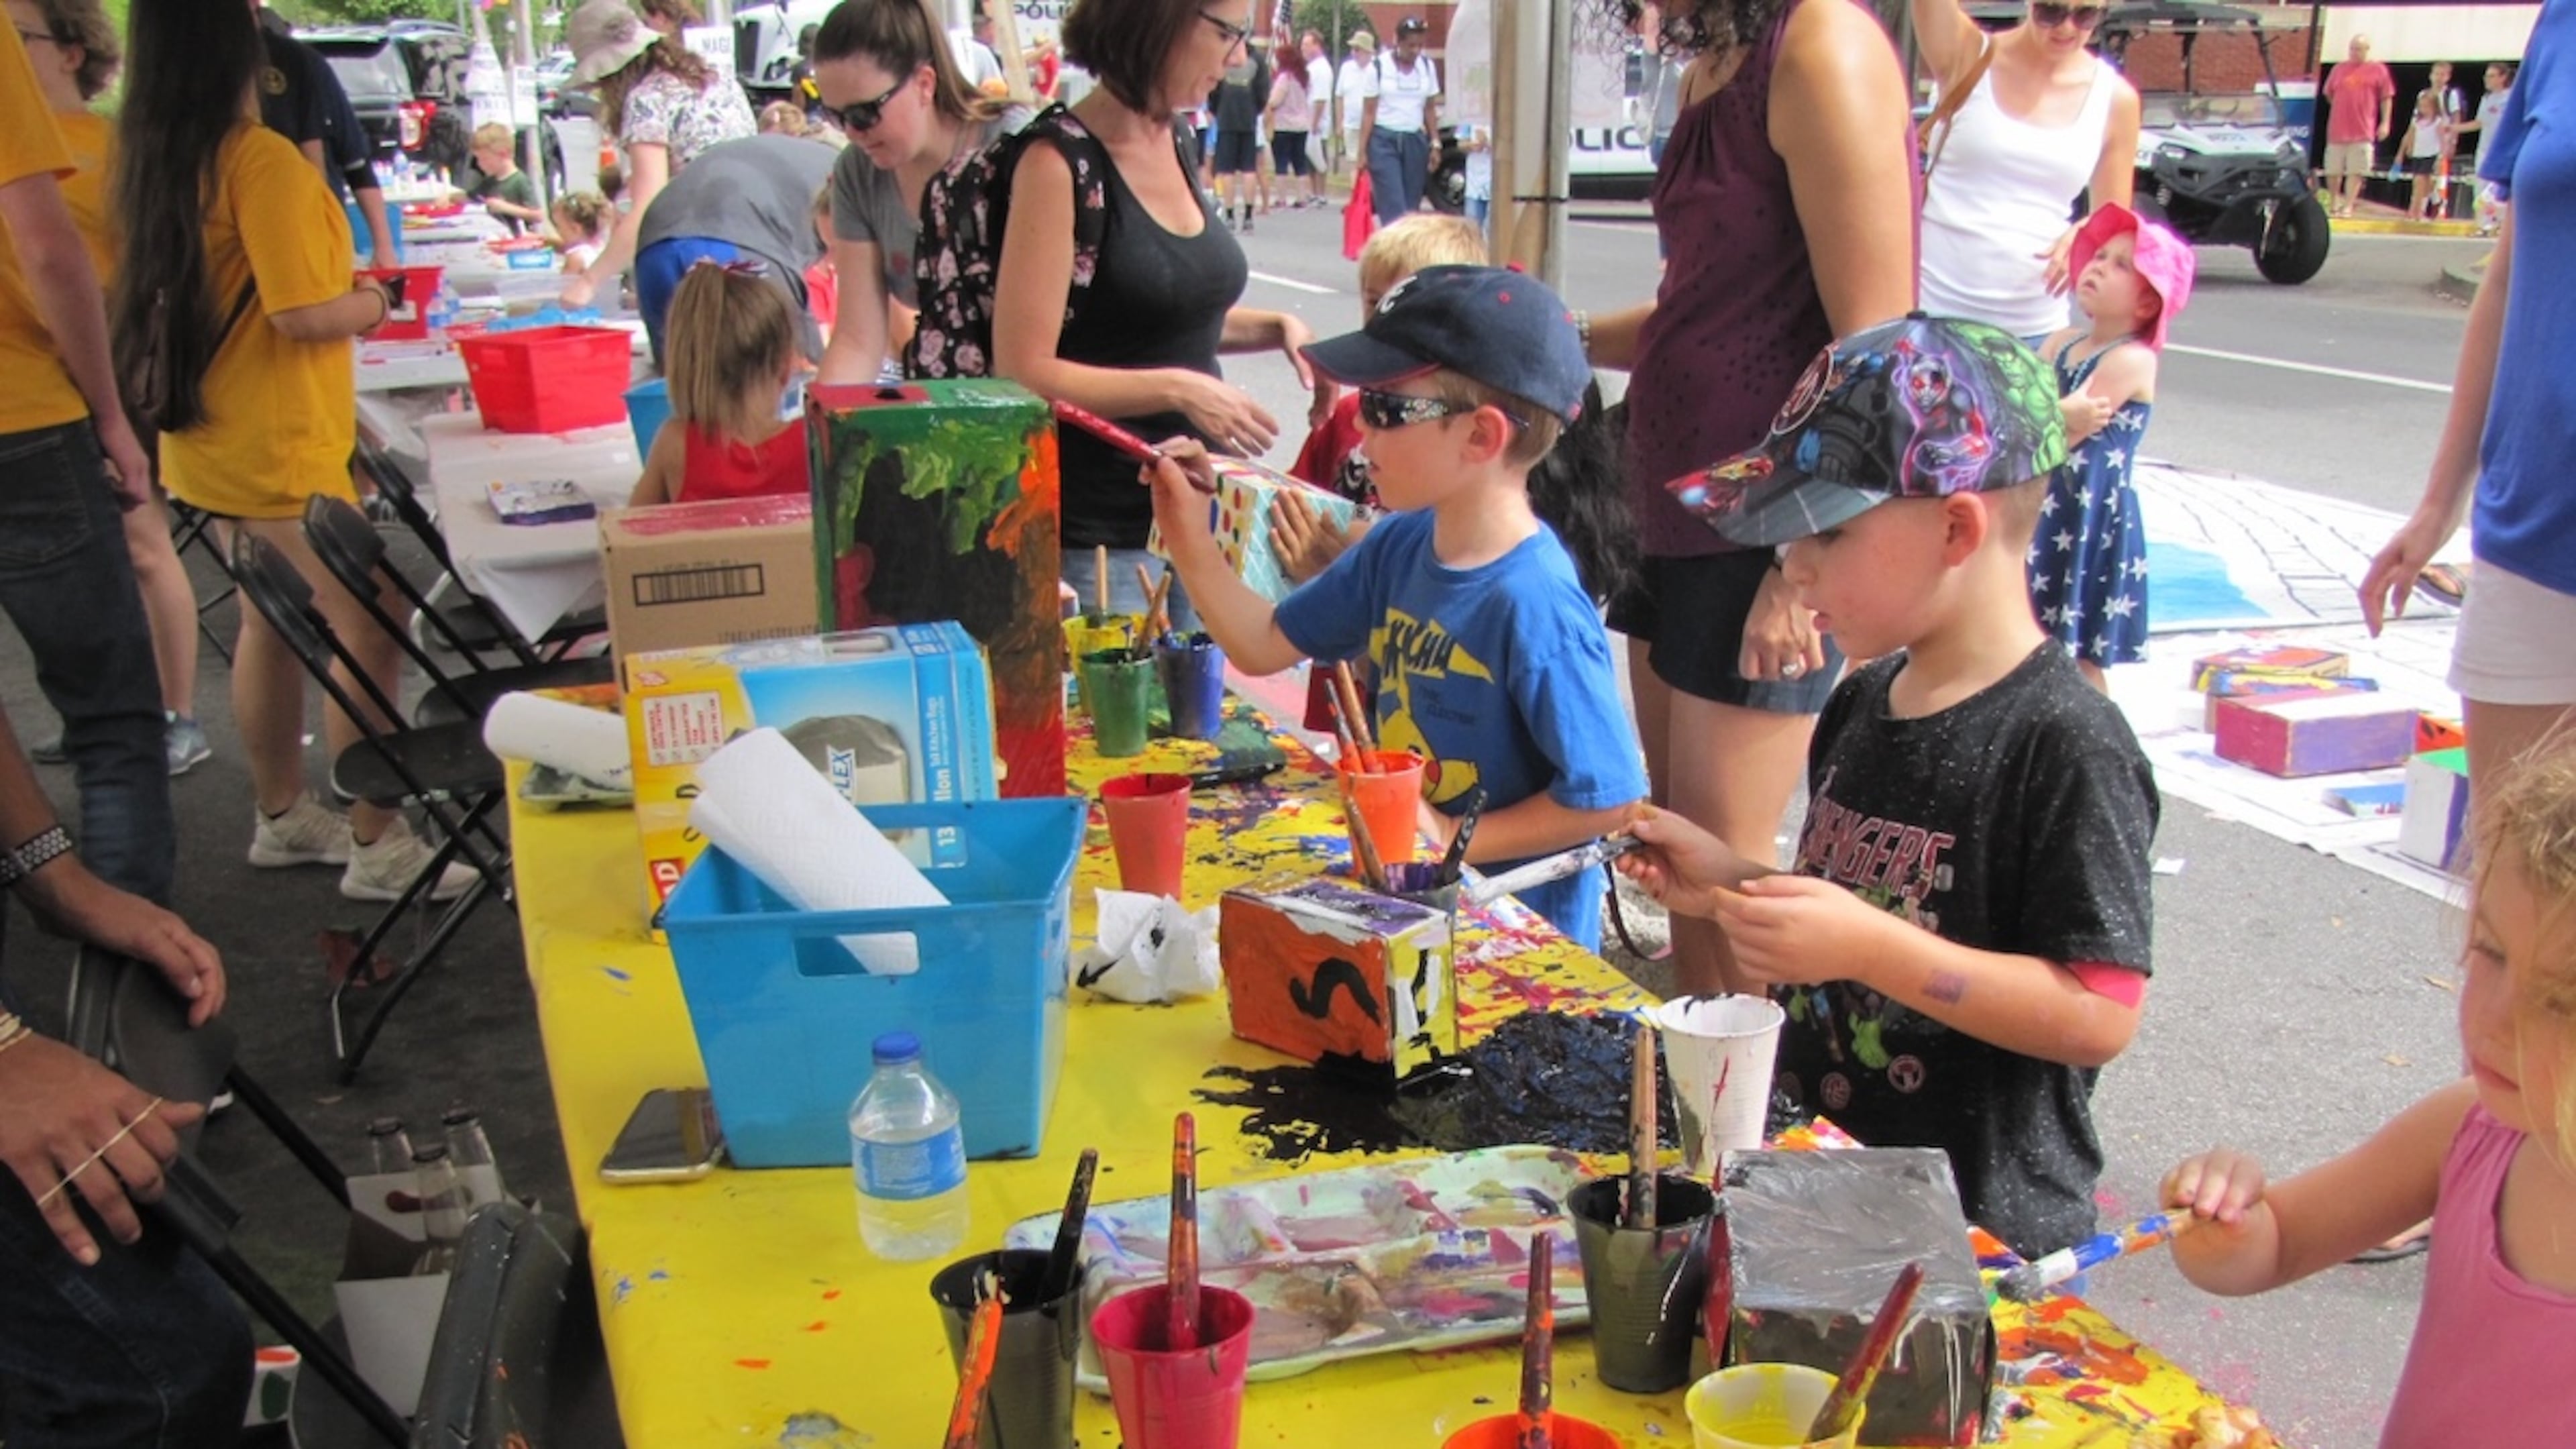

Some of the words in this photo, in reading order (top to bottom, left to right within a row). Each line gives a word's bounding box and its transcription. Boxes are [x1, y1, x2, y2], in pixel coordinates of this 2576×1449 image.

[1014, 4, 1072, 19] POLI
[1568, 125, 1646, 152] LIC
[933, 768, 952, 801] llon
